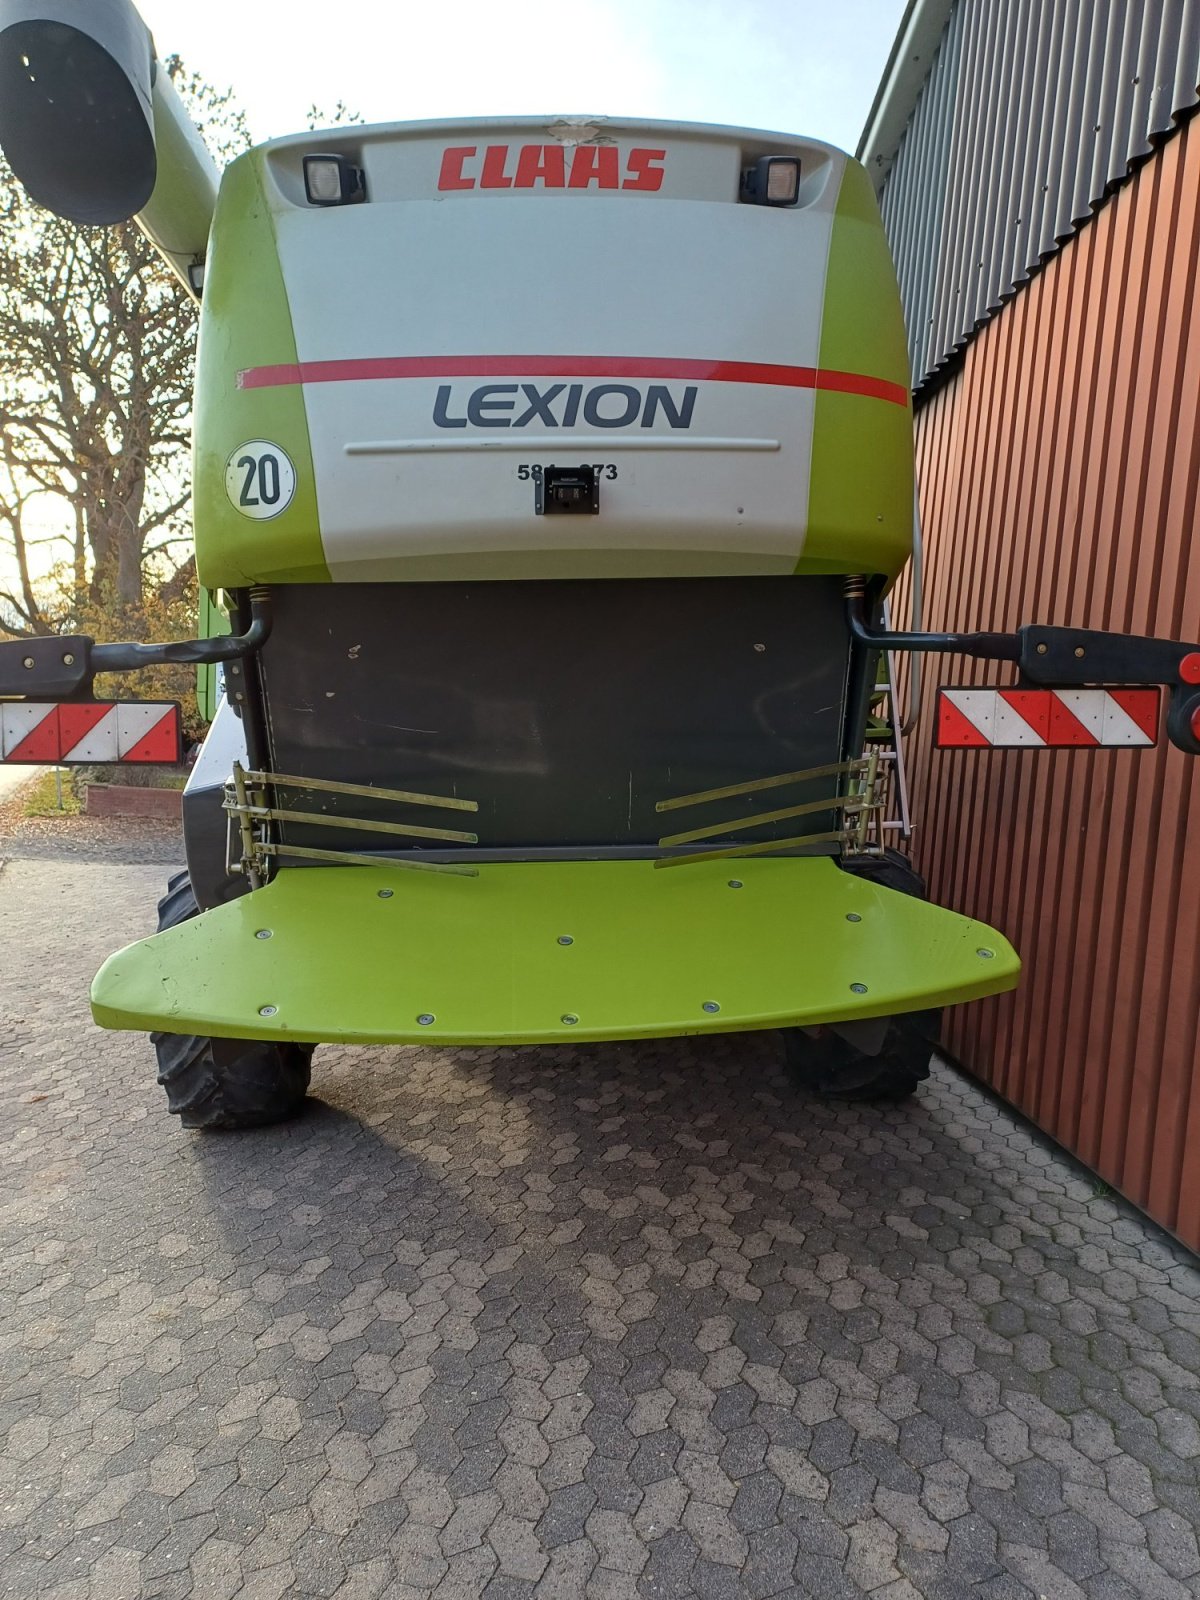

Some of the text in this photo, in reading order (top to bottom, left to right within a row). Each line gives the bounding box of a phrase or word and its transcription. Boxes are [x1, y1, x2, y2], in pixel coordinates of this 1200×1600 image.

[438, 145, 666, 191] CLAAS
[432, 383, 698, 429] LEXION
[237, 453, 280, 506] 20
